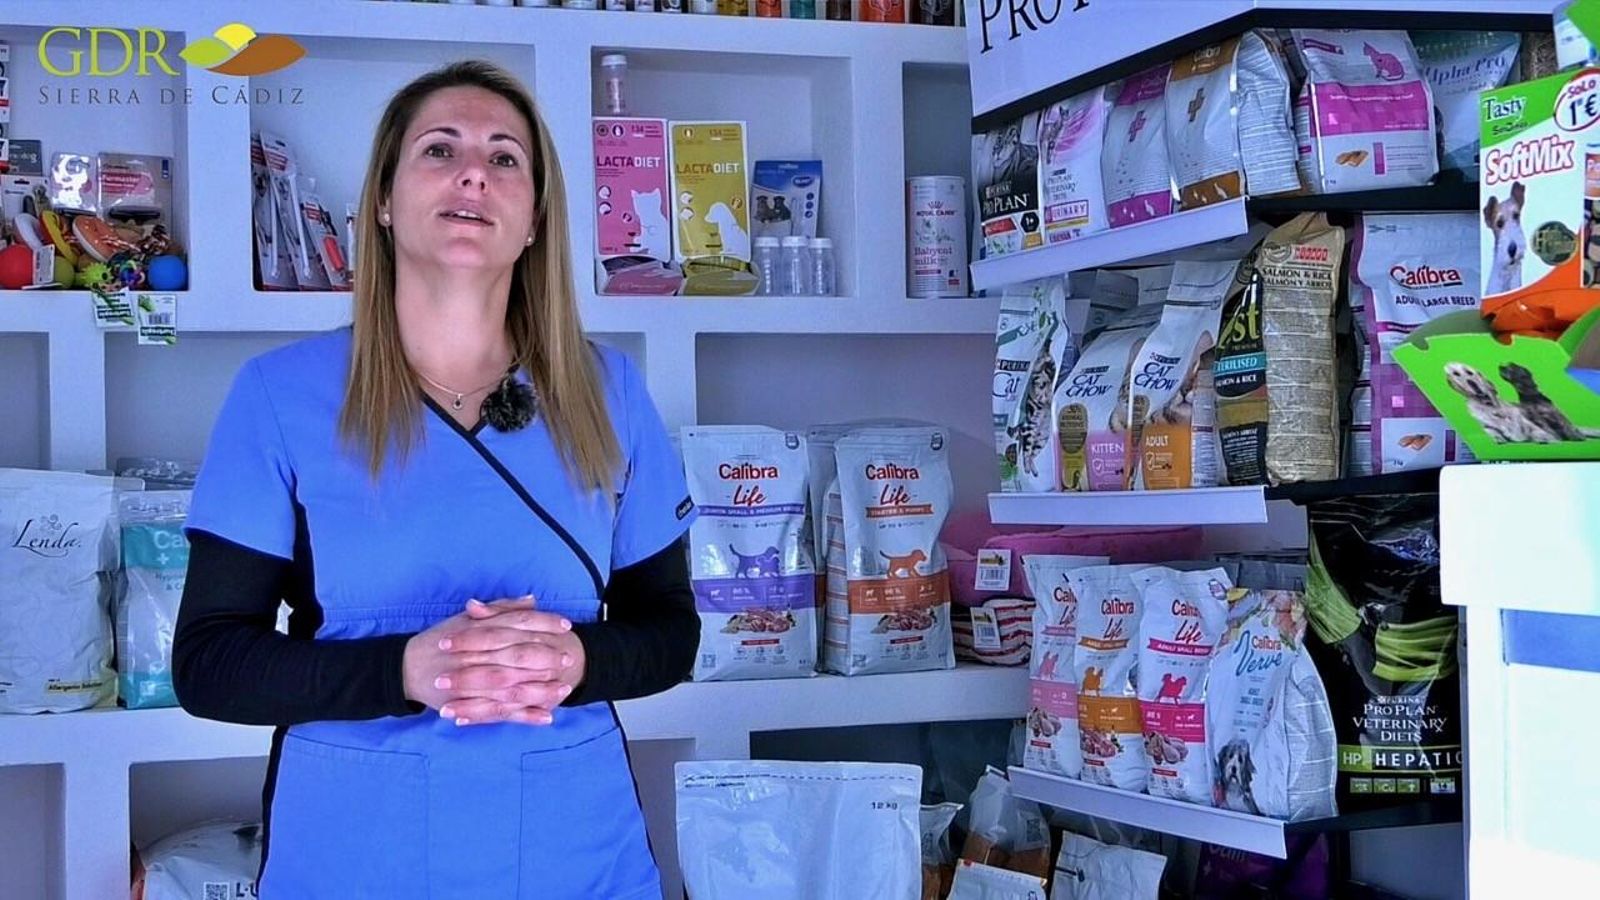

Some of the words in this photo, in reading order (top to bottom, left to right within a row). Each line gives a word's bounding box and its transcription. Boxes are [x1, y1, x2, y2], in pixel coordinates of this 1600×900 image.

[1482, 97, 1527, 121] Tasty
[596, 156, 661, 168] LACTADIET
[1486, 134, 1575, 186] SoftMix
[676, 162, 739, 175] LACTADIET
[994, 193, 1027, 213] PLAN
[1390, 265, 1462, 290] Calibra
[1451, 295, 1475, 306] BREED
[1143, 362, 1174, 377] CAT
[992, 372, 1020, 398] Cat
[1073, 374, 1101, 385] CAT
[1134, 373, 1178, 391] CHOW
[1066, 384, 1113, 398] CHOW
[1091, 442, 1124, 454] KITTEN
[1145, 435, 1168, 447] ADULT
[719, 462, 778, 480] Calibra
[865, 463, 920, 480] Calibra
[733, 485, 768, 506] Life
[881, 484, 911, 506] Life
[12, 519, 79, 557] Lenda
[1101, 597, 1134, 615] Calibra
[1103, 618, 1124, 641] Life
[1175, 620, 1203, 644] Life
[1252, 635, 1281, 650] Calibra
[1234, 630, 1282, 677] Verve
[1386, 696, 1421, 704] PURINA
[1364, 704, 1393, 716] PRO
[1395, 705, 1437, 716] PLAN
[1353, 717, 1448, 733] VETERINARY
[1380, 731, 1422, 742] DIETS
[1343, 752, 1362, 765] HP
[871, 802, 886, 810] 12
